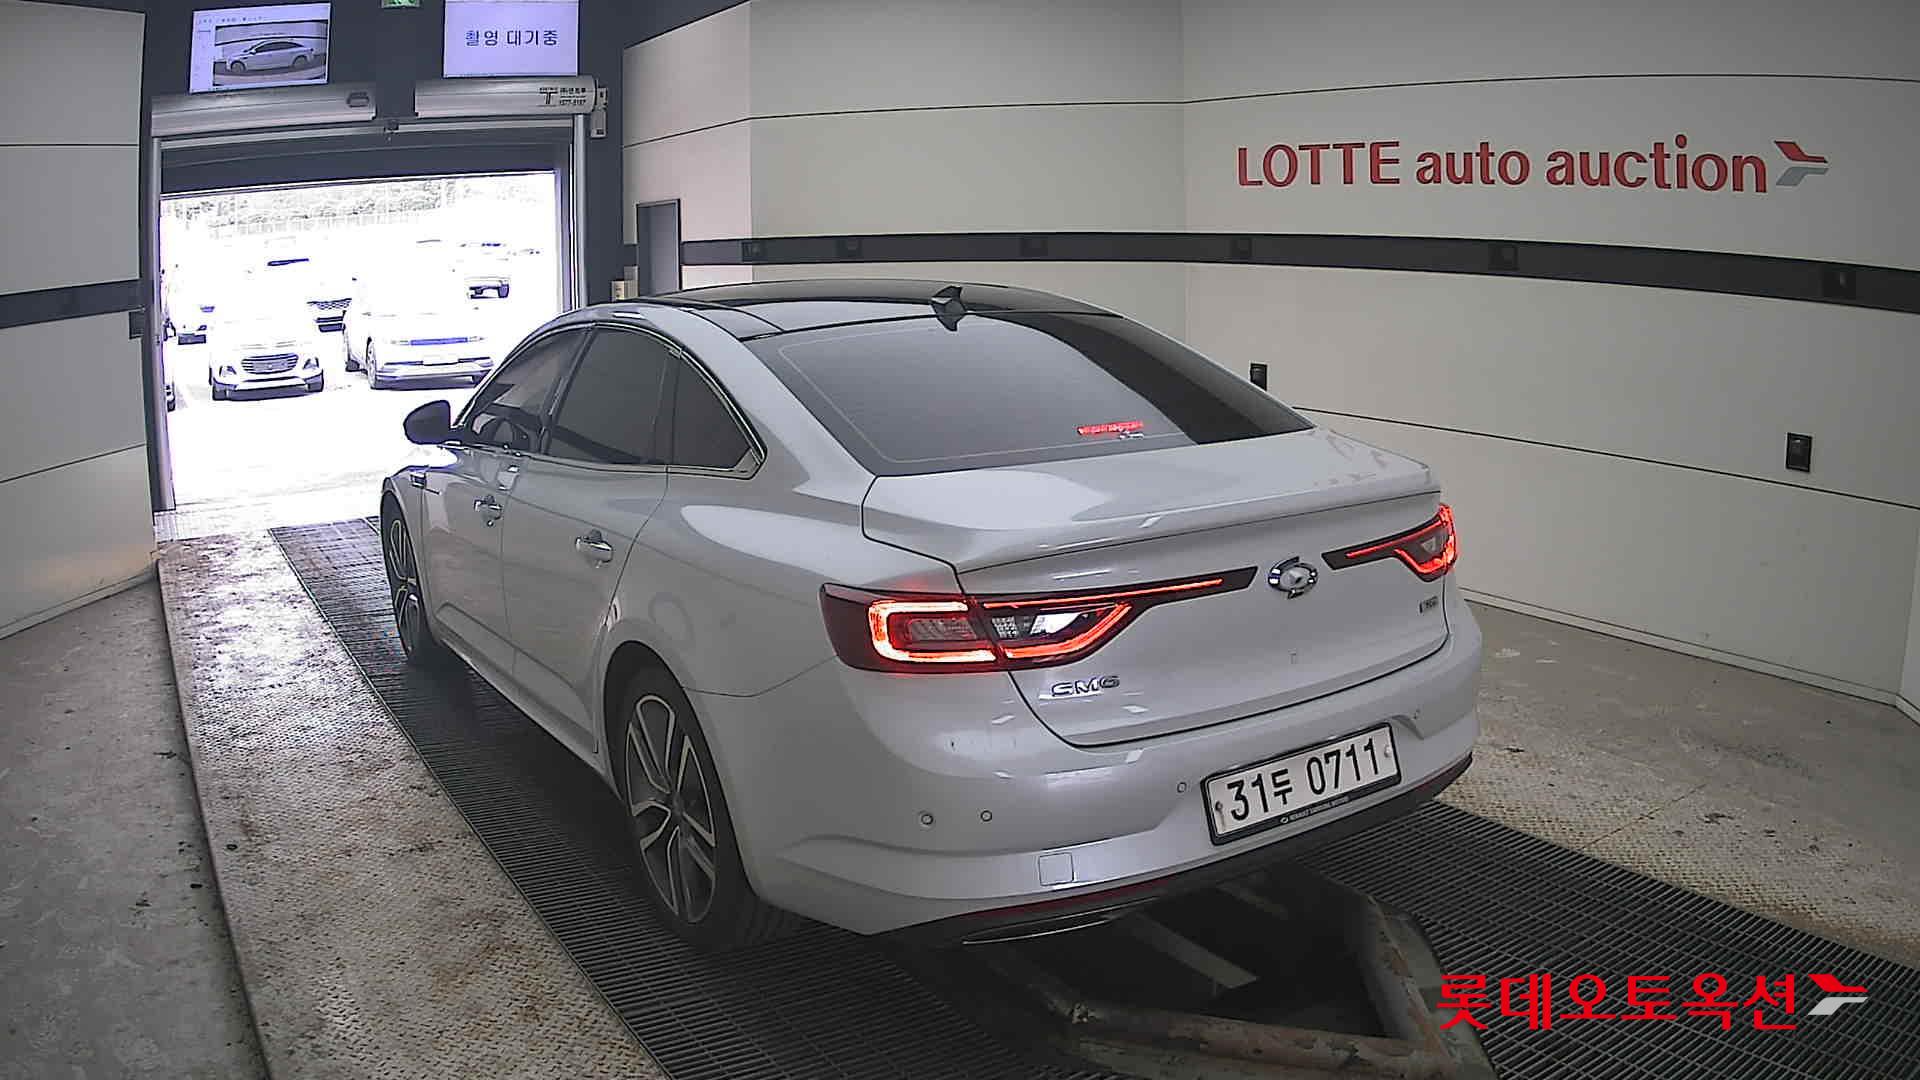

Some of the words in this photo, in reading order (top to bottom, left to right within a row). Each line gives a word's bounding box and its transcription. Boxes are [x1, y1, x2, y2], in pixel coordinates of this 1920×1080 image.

[506, 29, 559, 46] 대기중
[1237, 141, 1400, 187] LOTTE
[1416, 141, 1531, 185] auto
[1546, 134, 1768, 193] auction
[1051, 675, 1121, 697] SM6
[1226, 768, 1293, 821] 31두
[1306, 737, 1379, 795] 0711
